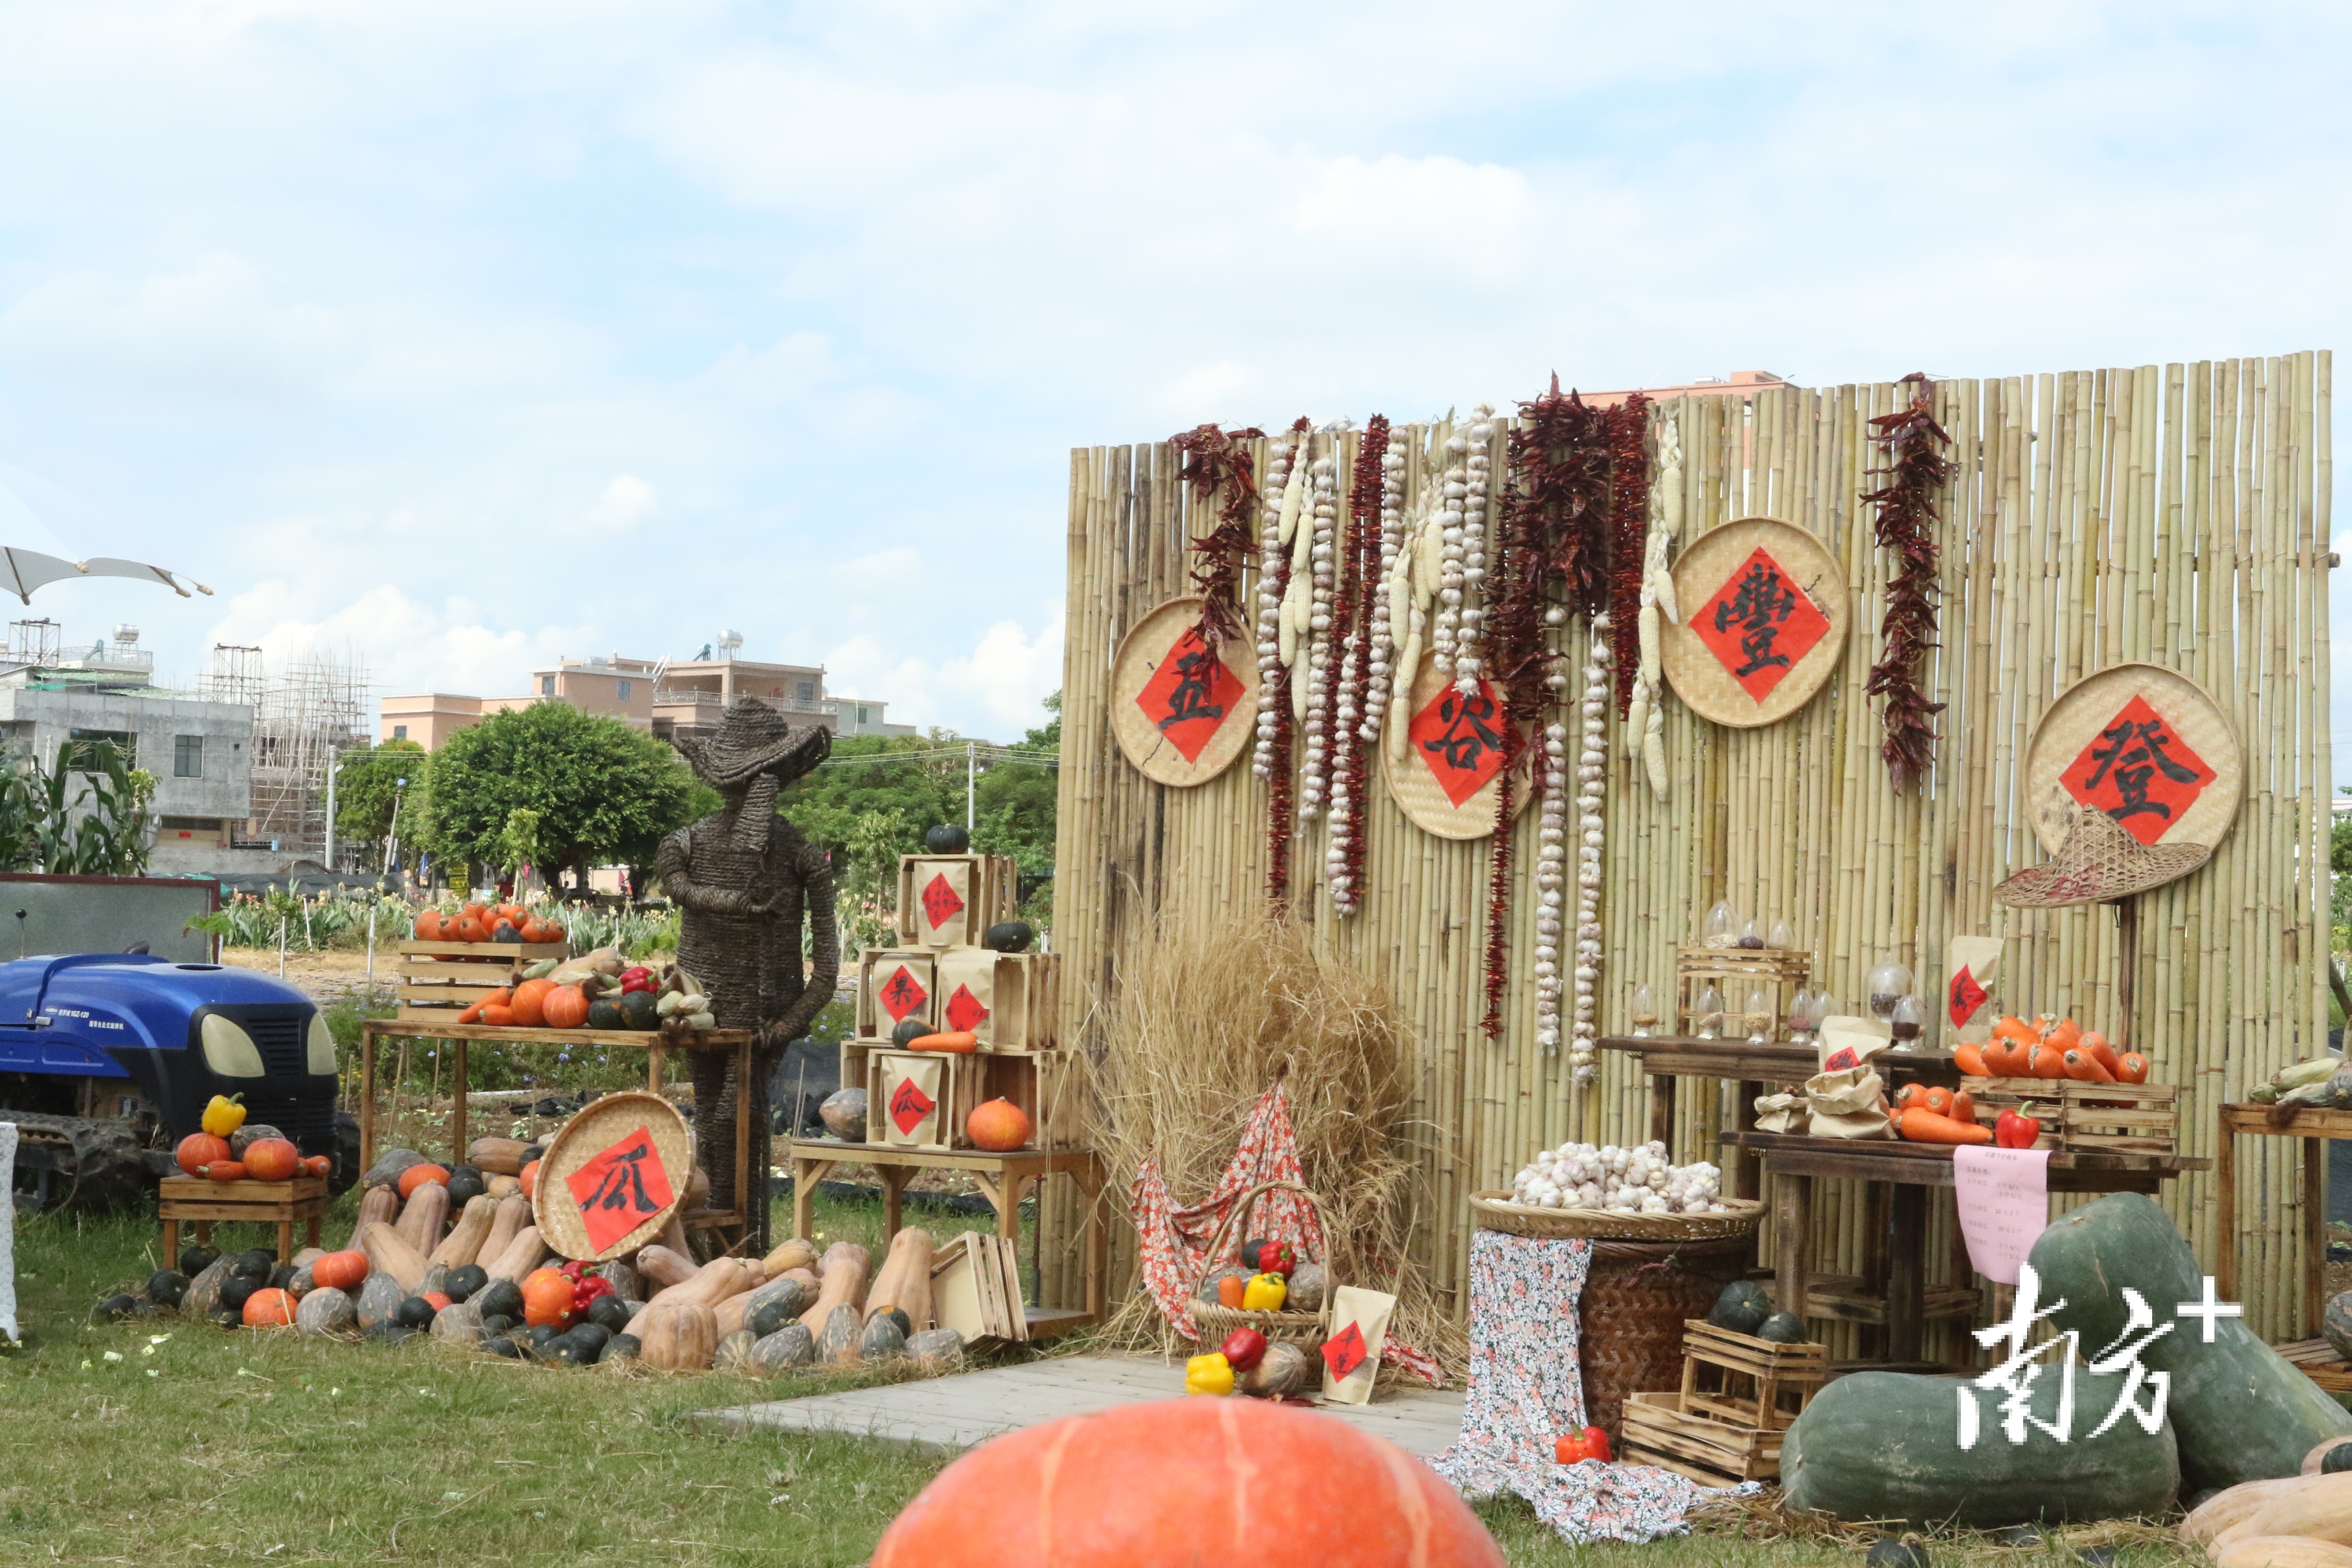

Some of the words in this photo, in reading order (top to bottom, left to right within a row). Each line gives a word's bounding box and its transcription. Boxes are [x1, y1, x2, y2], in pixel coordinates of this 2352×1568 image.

[1158, 652, 1222, 729] 五
[1424, 695, 1504, 771] 谷
[2085, 720, 2199, 821] 登
[890, 976, 913, 1005] 果
[894, 1088, 925, 1115] 瓜
[579, 1144, 659, 1213] 瓜
